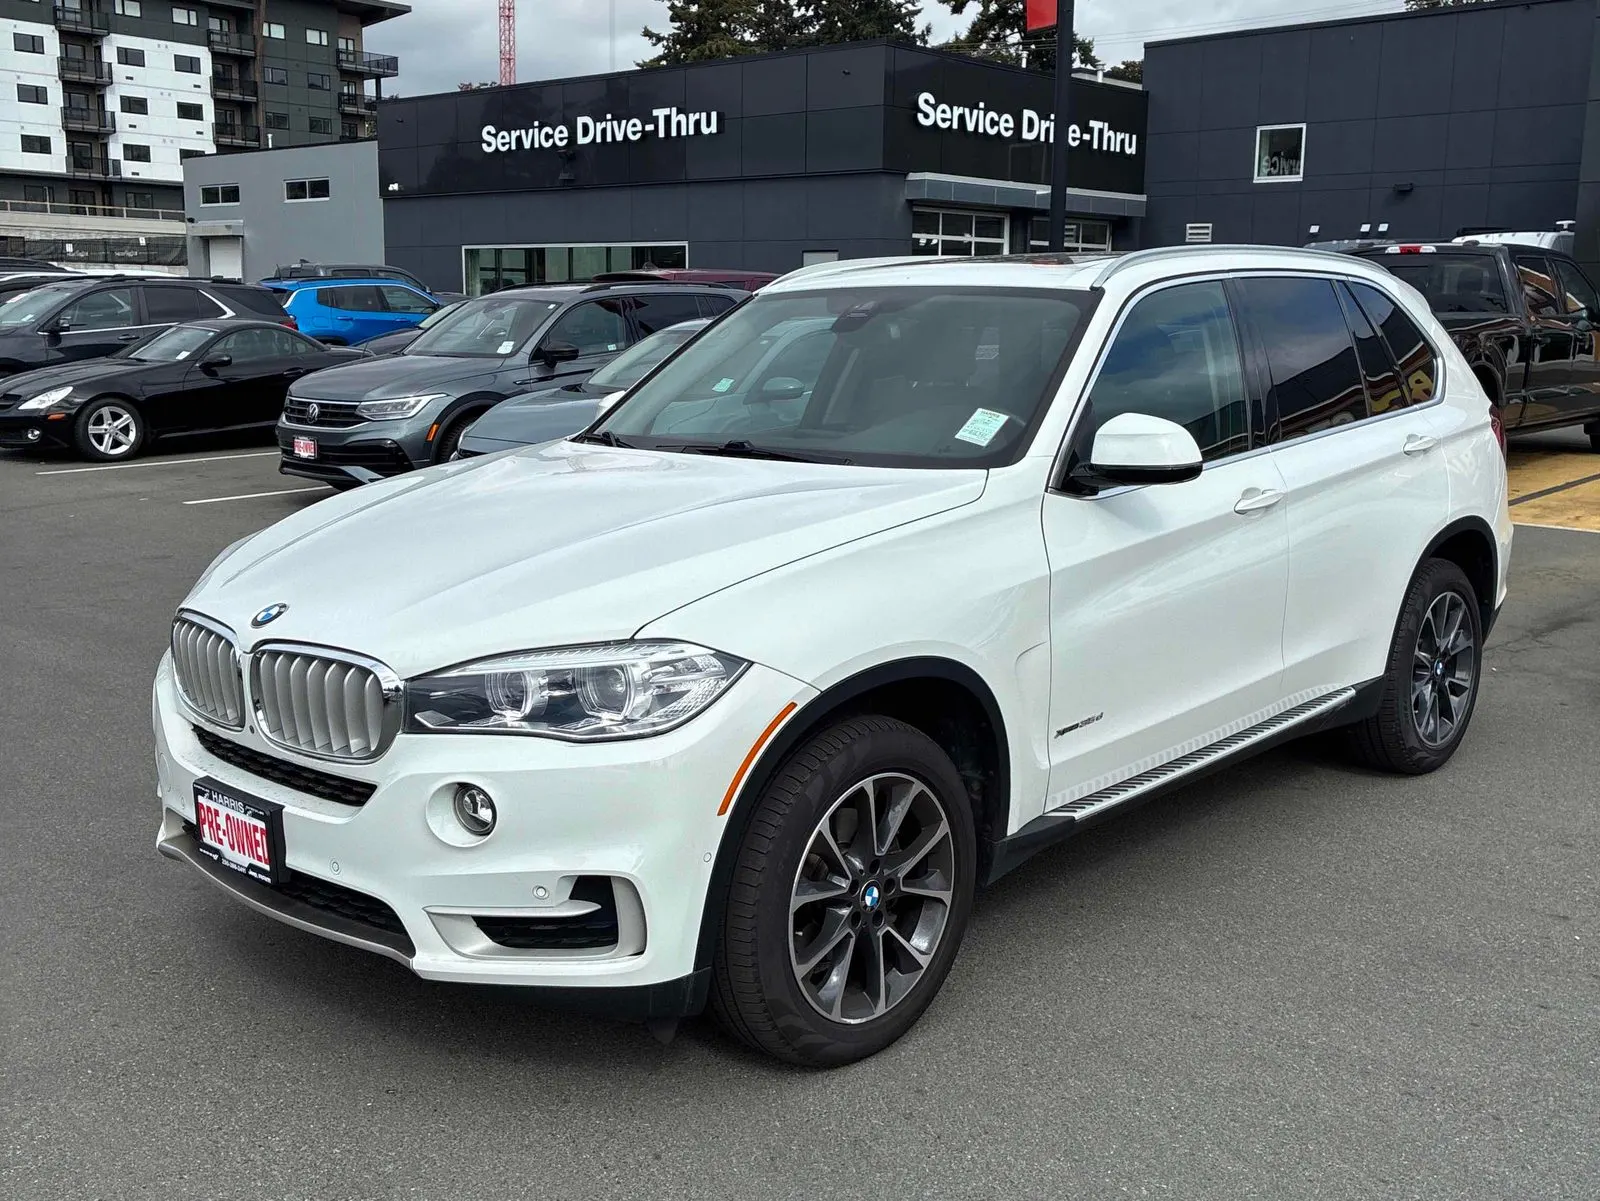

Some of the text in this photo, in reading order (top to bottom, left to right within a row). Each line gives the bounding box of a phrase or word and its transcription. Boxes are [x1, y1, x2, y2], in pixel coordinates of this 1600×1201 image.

[481, 107, 717, 153] Service Drive-Thru
[917, 92, 1137, 155] Service Drie-Thru
[212, 791, 245, 813] HARRIS
